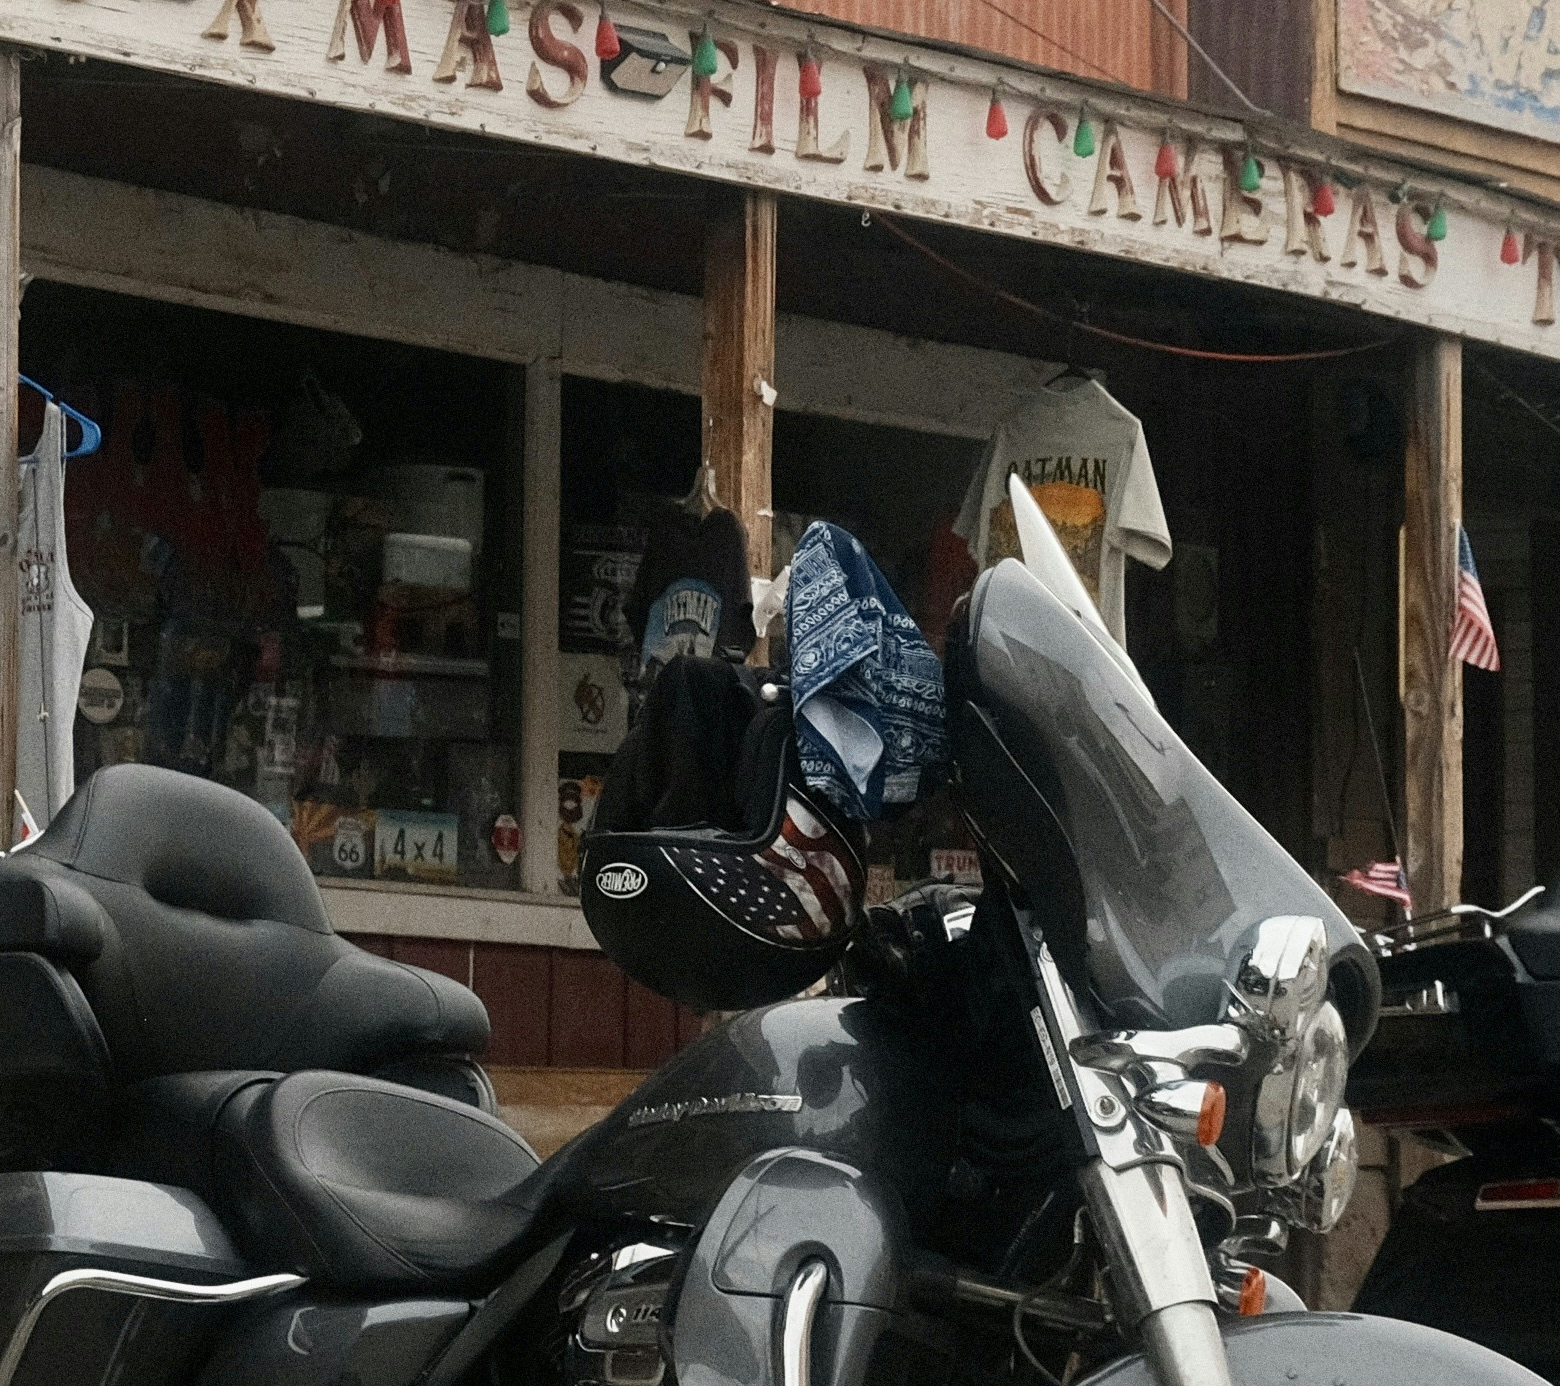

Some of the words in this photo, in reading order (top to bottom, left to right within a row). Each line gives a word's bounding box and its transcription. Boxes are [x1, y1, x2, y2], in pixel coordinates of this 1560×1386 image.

[684, 29, 931, 182] FILM
[1021, 104, 1443, 289] CAMERAS
[337, 842, 360, 863] 66
[598, 867, 644, 893] PREMIER
